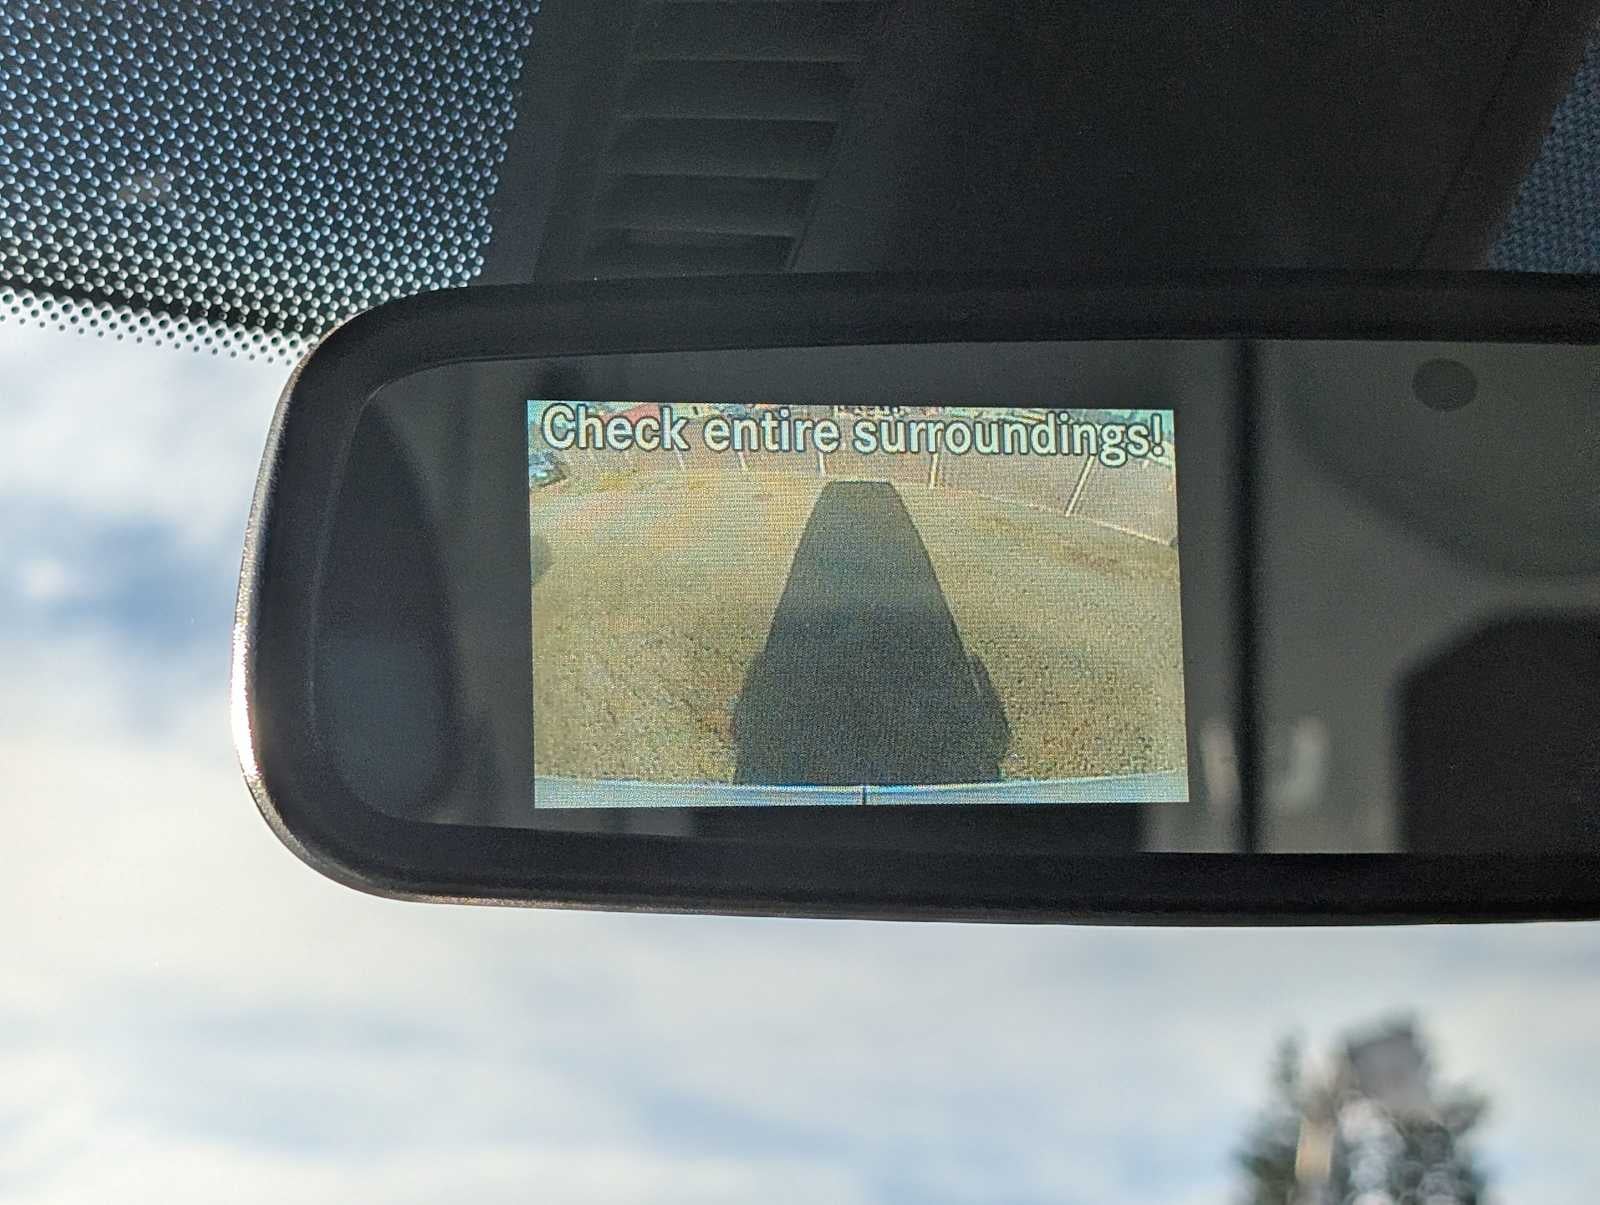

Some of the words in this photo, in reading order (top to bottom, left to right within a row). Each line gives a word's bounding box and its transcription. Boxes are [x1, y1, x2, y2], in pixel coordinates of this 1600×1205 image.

[542, 403, 690, 450] Check
[703, 407, 841, 453] entire
[852, 410, 1166, 467] surroundings!
